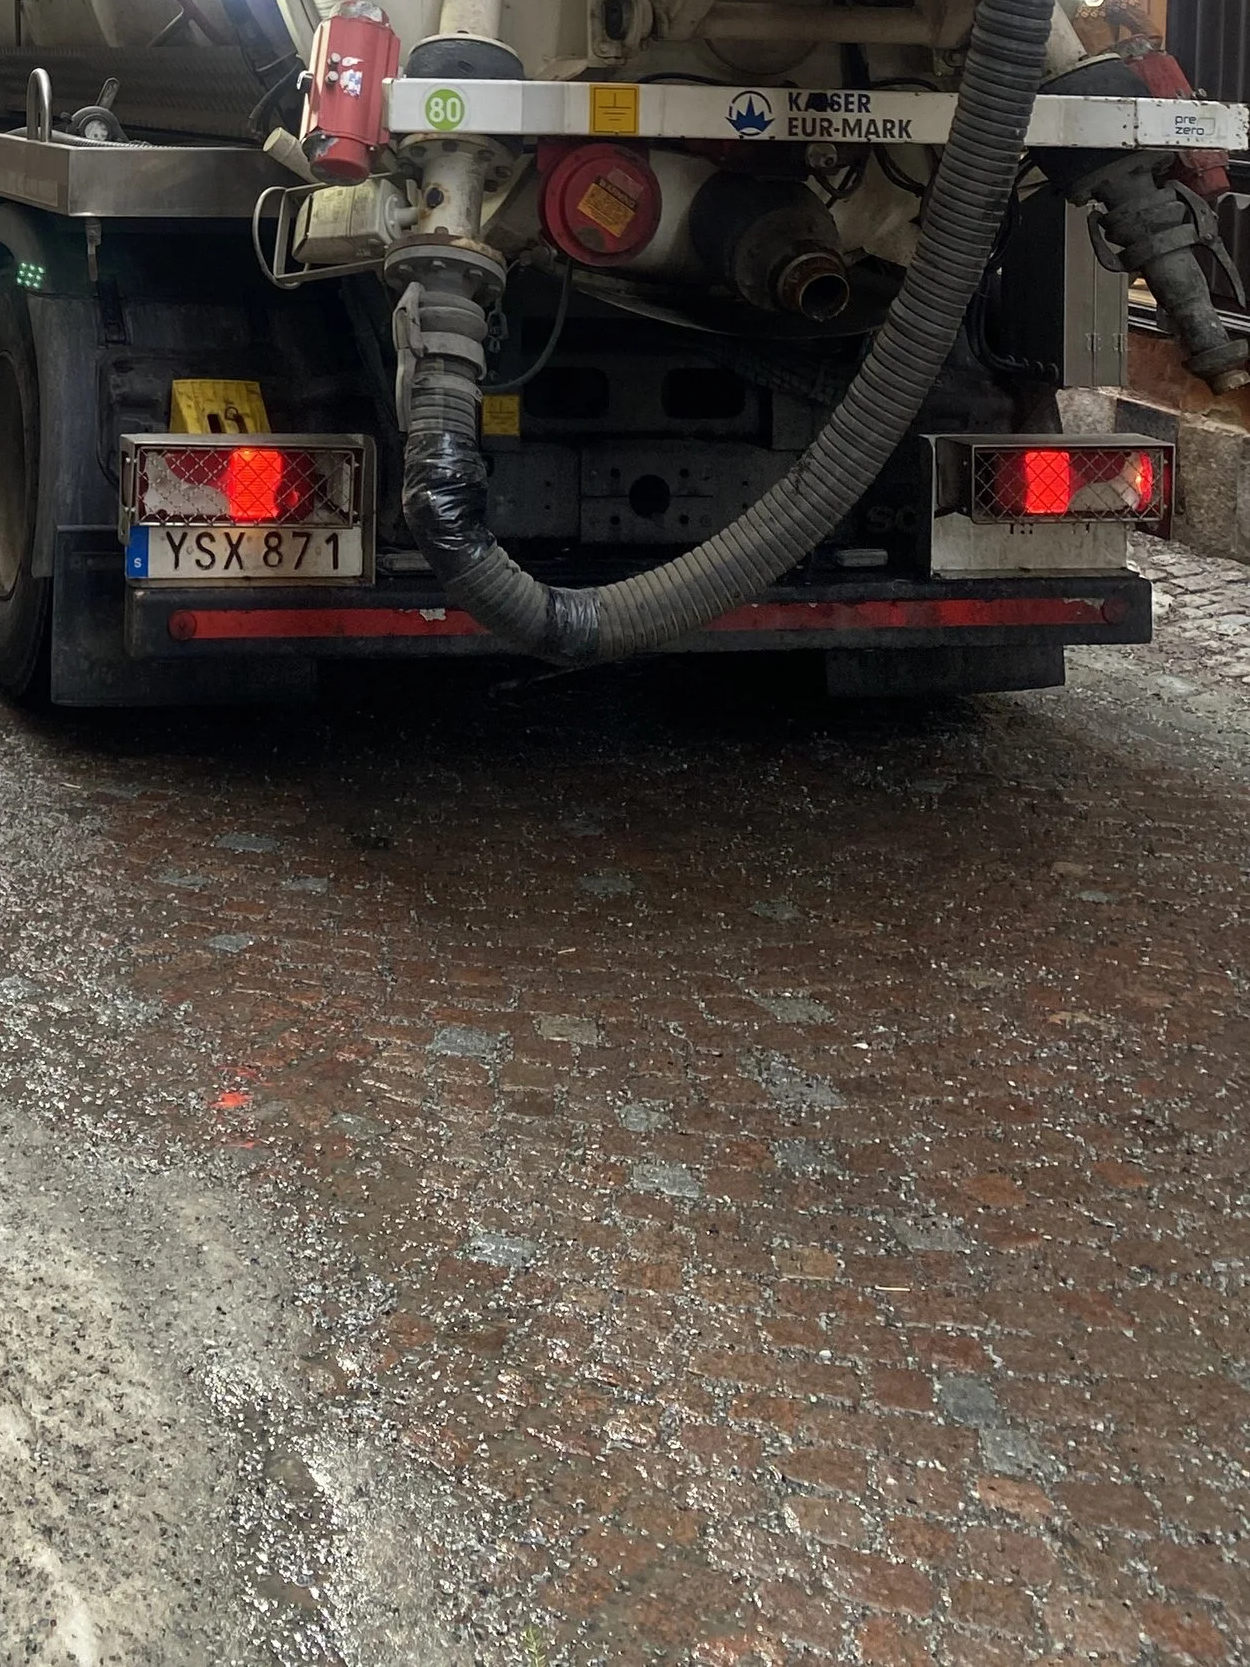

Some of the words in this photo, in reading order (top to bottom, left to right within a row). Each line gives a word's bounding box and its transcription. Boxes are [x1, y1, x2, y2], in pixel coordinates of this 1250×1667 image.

[430, 97, 460, 123] 80
[788, 117, 913, 139] EUR-MARK
[1175, 115, 1197, 125] pre
[1175, 126, 1205, 136] zero
[165, 531, 245, 571] YSX
[262, 531, 340, 571] 871
[133, 556, 142, 569] S
